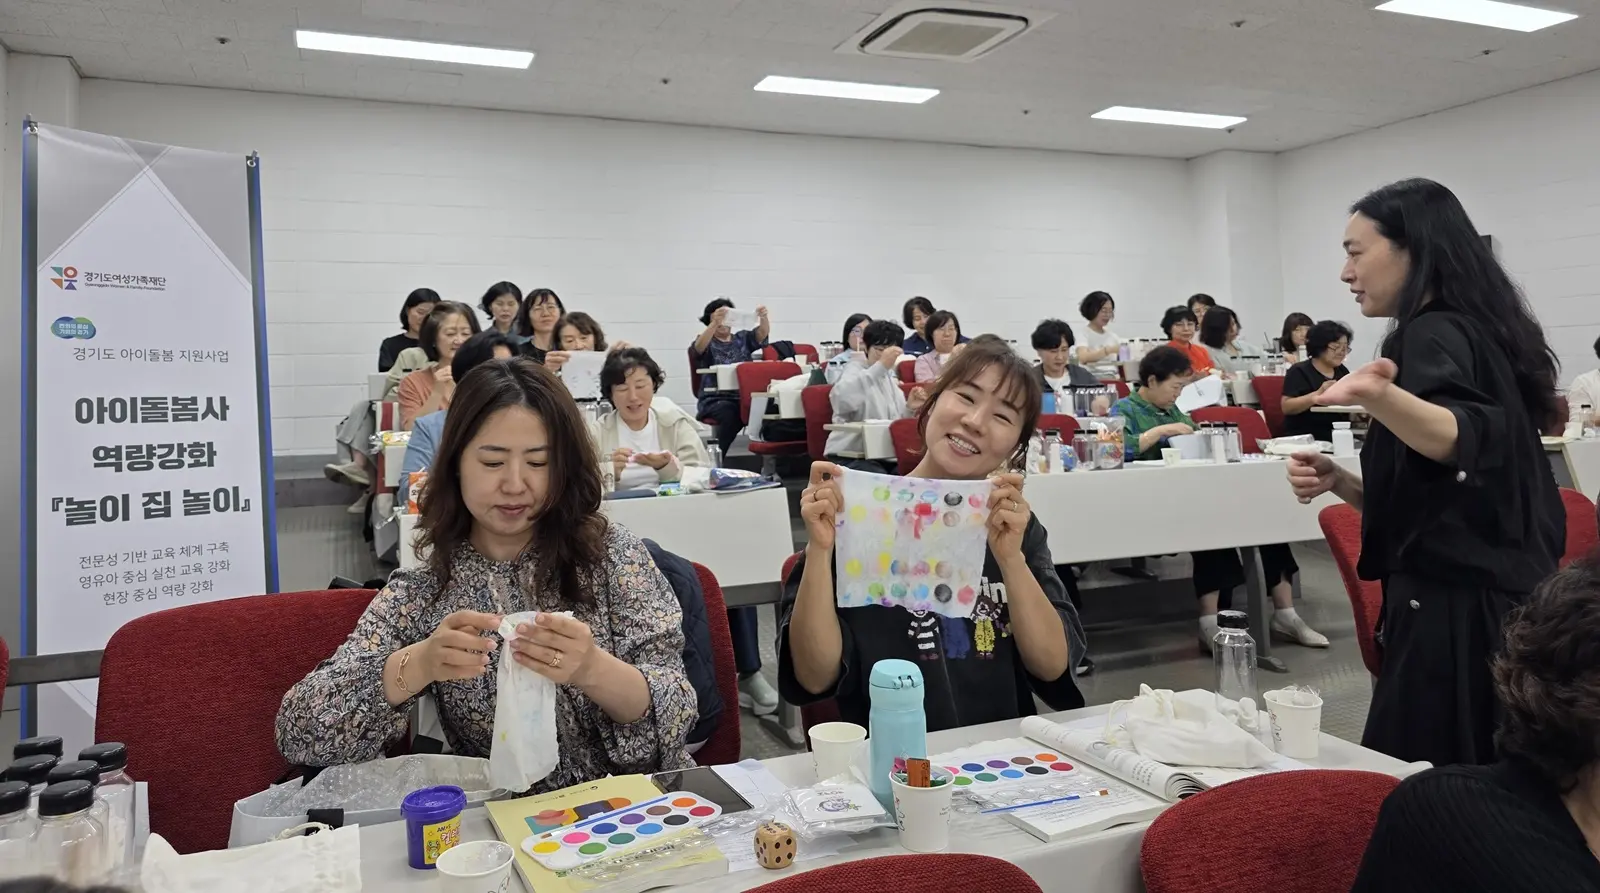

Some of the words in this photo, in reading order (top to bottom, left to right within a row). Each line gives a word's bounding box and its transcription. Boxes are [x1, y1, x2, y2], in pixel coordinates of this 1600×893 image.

[84, 272, 166, 286] 경기도여성가족재단
[73, 348, 116, 361] 경기도
[121, 348, 174, 362] 아이돌봄
[179, 350, 229, 363] 지원사업
[75, 396, 230, 424] 아이돌봄사
[92, 441, 217, 473] 역량강화
[52, 493, 130, 526] 『놀이
[142, 491, 172, 520] 집
[182, 486, 251, 516] 놀이』
[79, 553, 118, 569] 전문성
[123, 550, 148, 564] 기반
[152, 547, 176, 561] 교육
[179, 543, 203, 558] 체계
[207, 541, 230, 555] 구축
[79, 572, 119, 589] 영유아
[122, 569, 148, 584] 중심
[152, 566, 176, 581] 실천
[180, 563, 204, 576] 교육
[207, 559, 231, 573] 강화
[103, 591, 129, 606] 현장
[133, 587, 158, 602] 중심
[162, 583, 186, 597] 역량
[190, 579, 214, 594] 강화
[978, 576, 1008, 604] in
